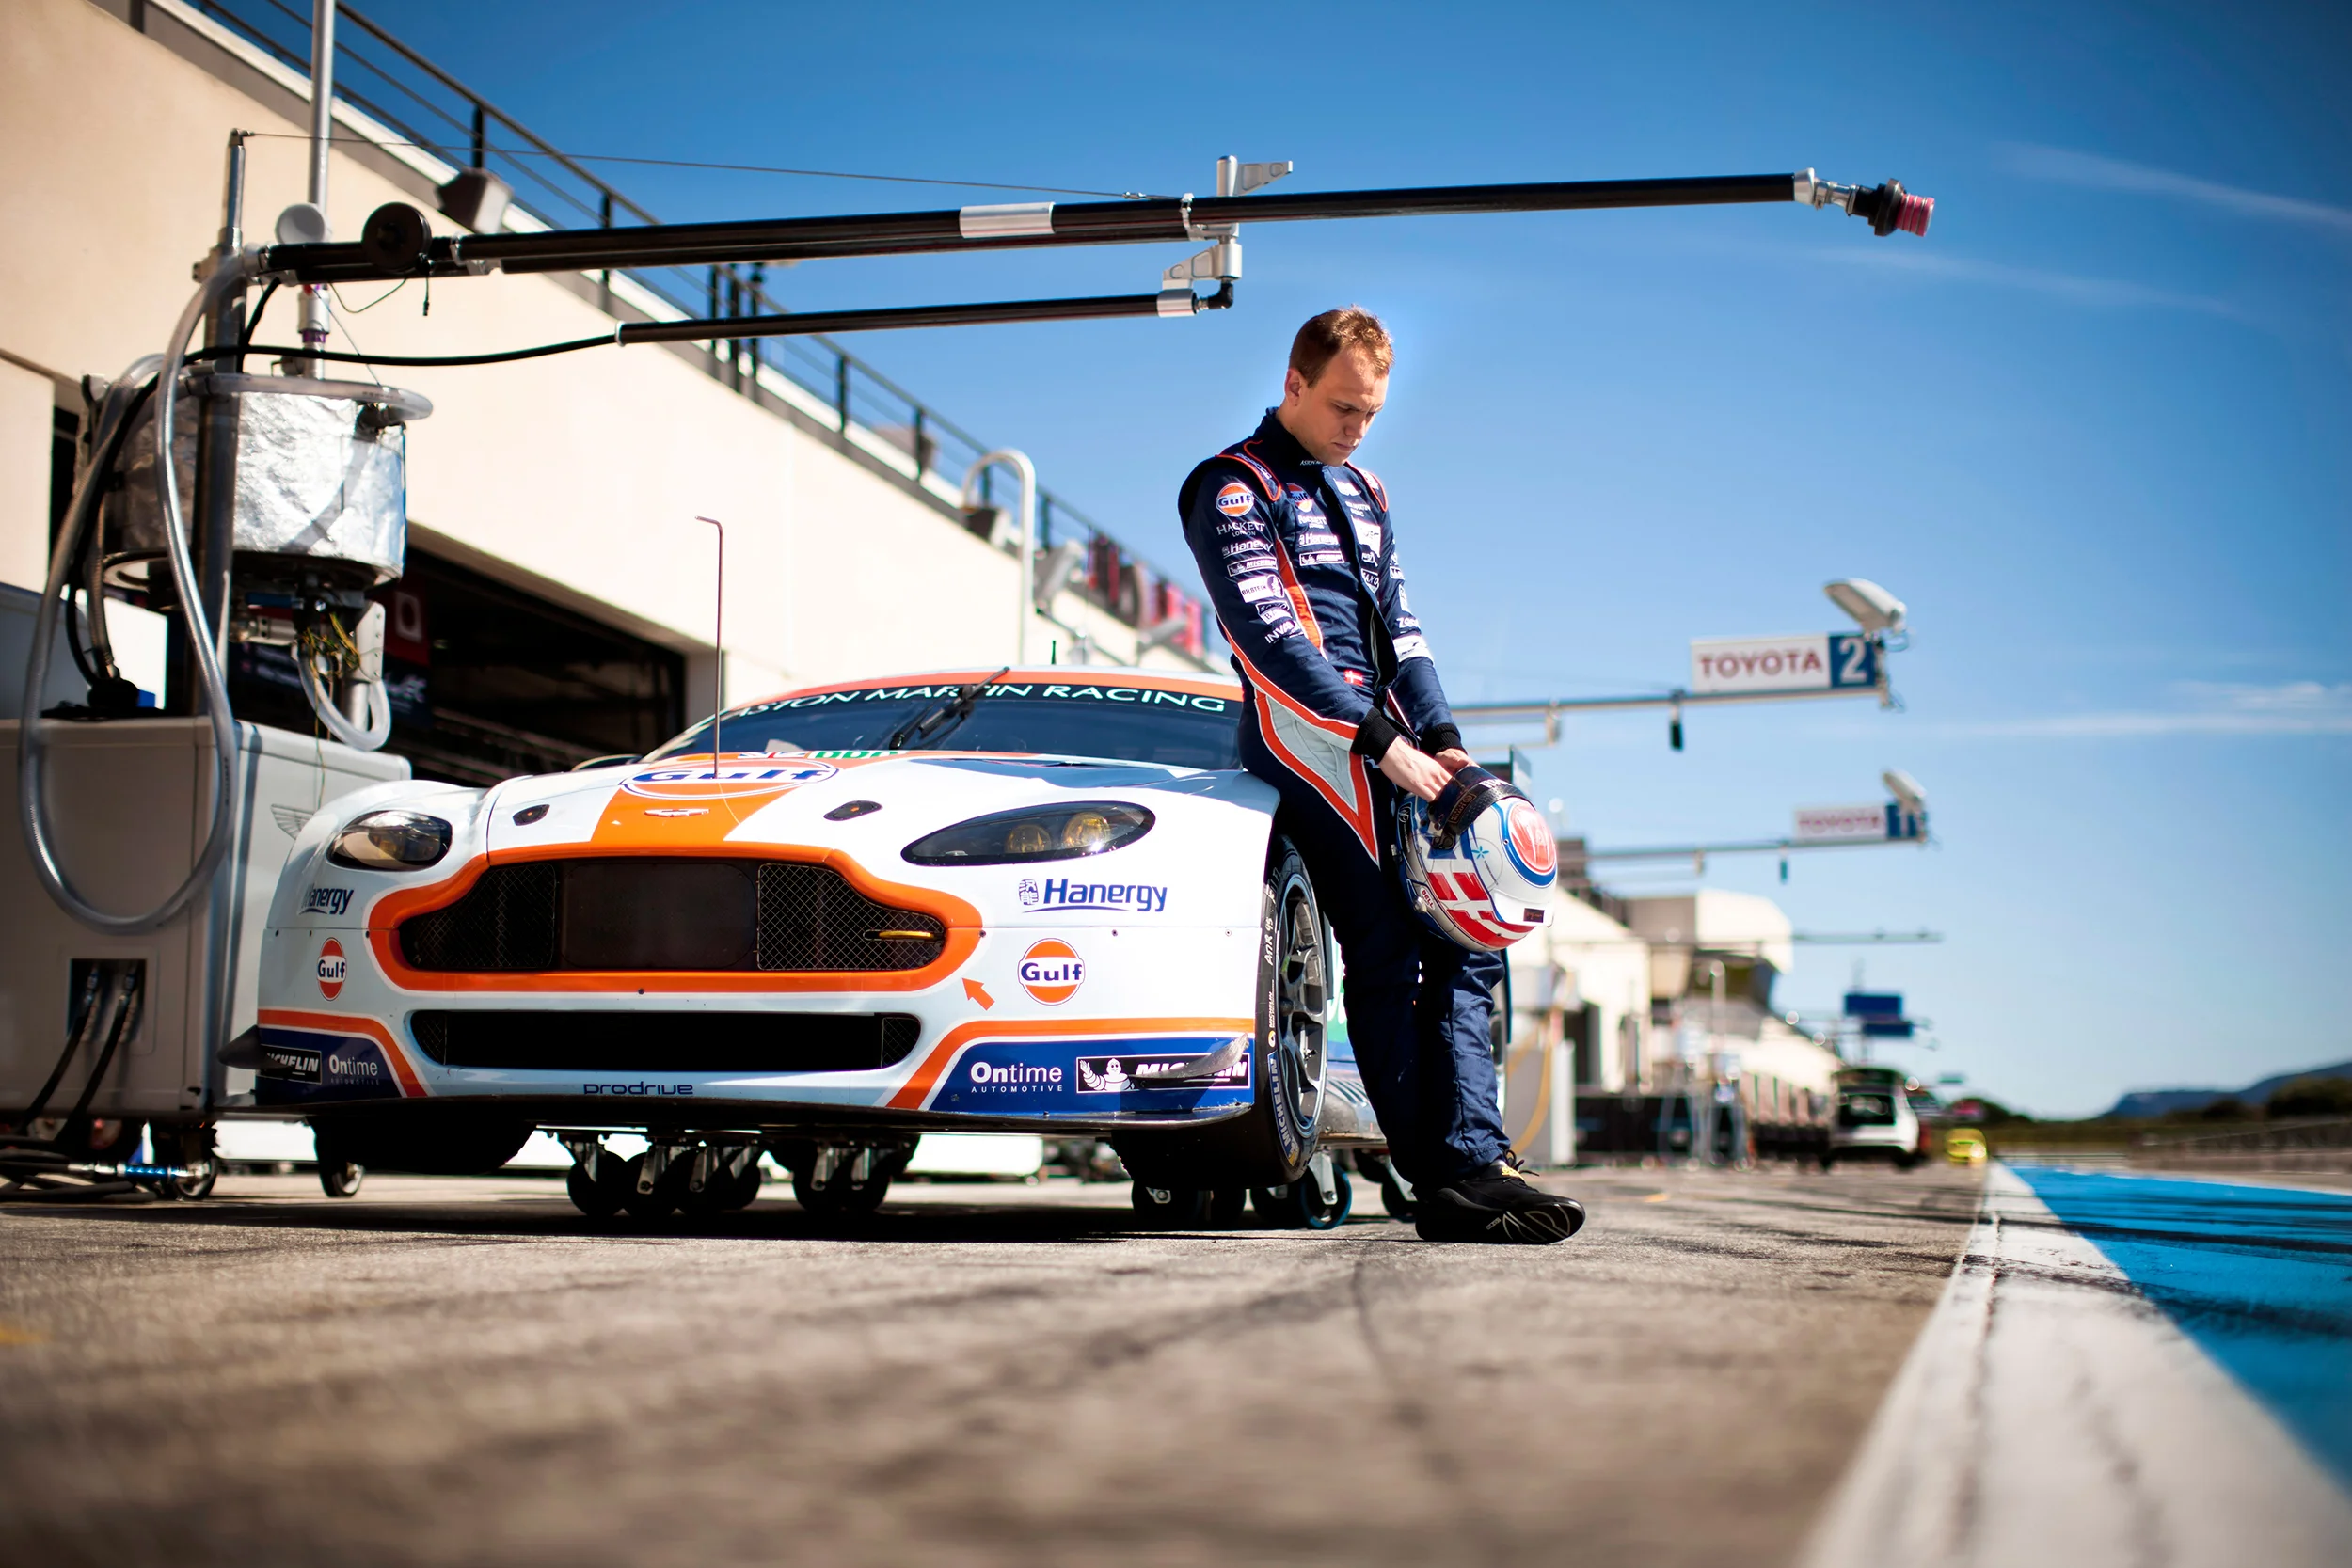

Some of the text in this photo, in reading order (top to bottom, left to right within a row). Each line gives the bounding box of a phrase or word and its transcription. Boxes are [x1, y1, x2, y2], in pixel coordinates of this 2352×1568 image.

[1218, 495, 1251, 507] Gulf
[1699, 637, 1867, 684] TOYOTA 2
[1043, 684, 1226, 712] RACING
[1043, 878, 1168, 912] Hanergy
[317, 959, 346, 978] Gulf
[1020, 961, 1083, 981] Gulf
[329, 1054, 378, 1076] Ontime
[970, 1061, 1063, 1084] Ontime
[1136, 1061, 1248, 1078] MIIN
[583, 1081, 694, 1095] prodrive
[971, 1085, 1063, 1093] AUTOMOTIVE
[1270, 1057, 1293, 1146] MICHELIN
